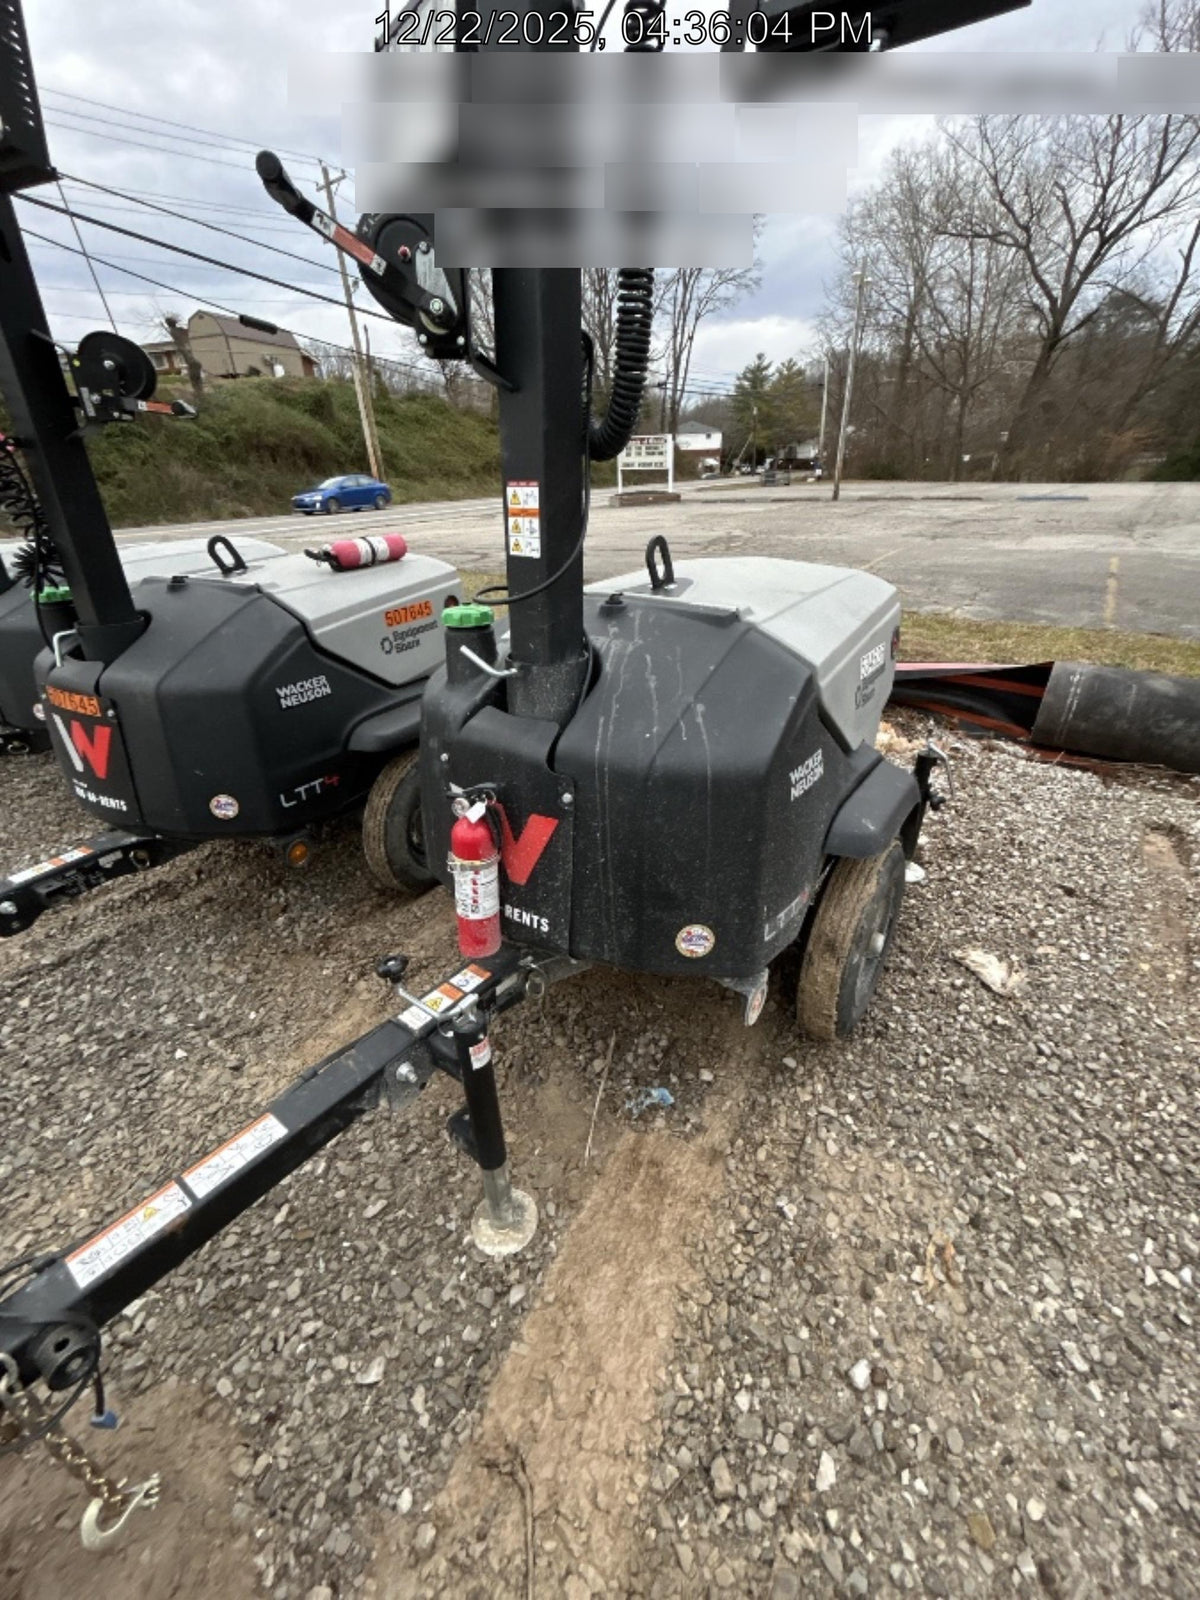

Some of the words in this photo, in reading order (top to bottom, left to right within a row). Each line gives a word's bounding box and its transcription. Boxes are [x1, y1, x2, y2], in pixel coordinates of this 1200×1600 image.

[384, 600, 433, 628] 507645
[275, 675, 327, 698] WACKER
[280, 683, 332, 708] NEUSON
[789, 747, 823, 785] WACKER
